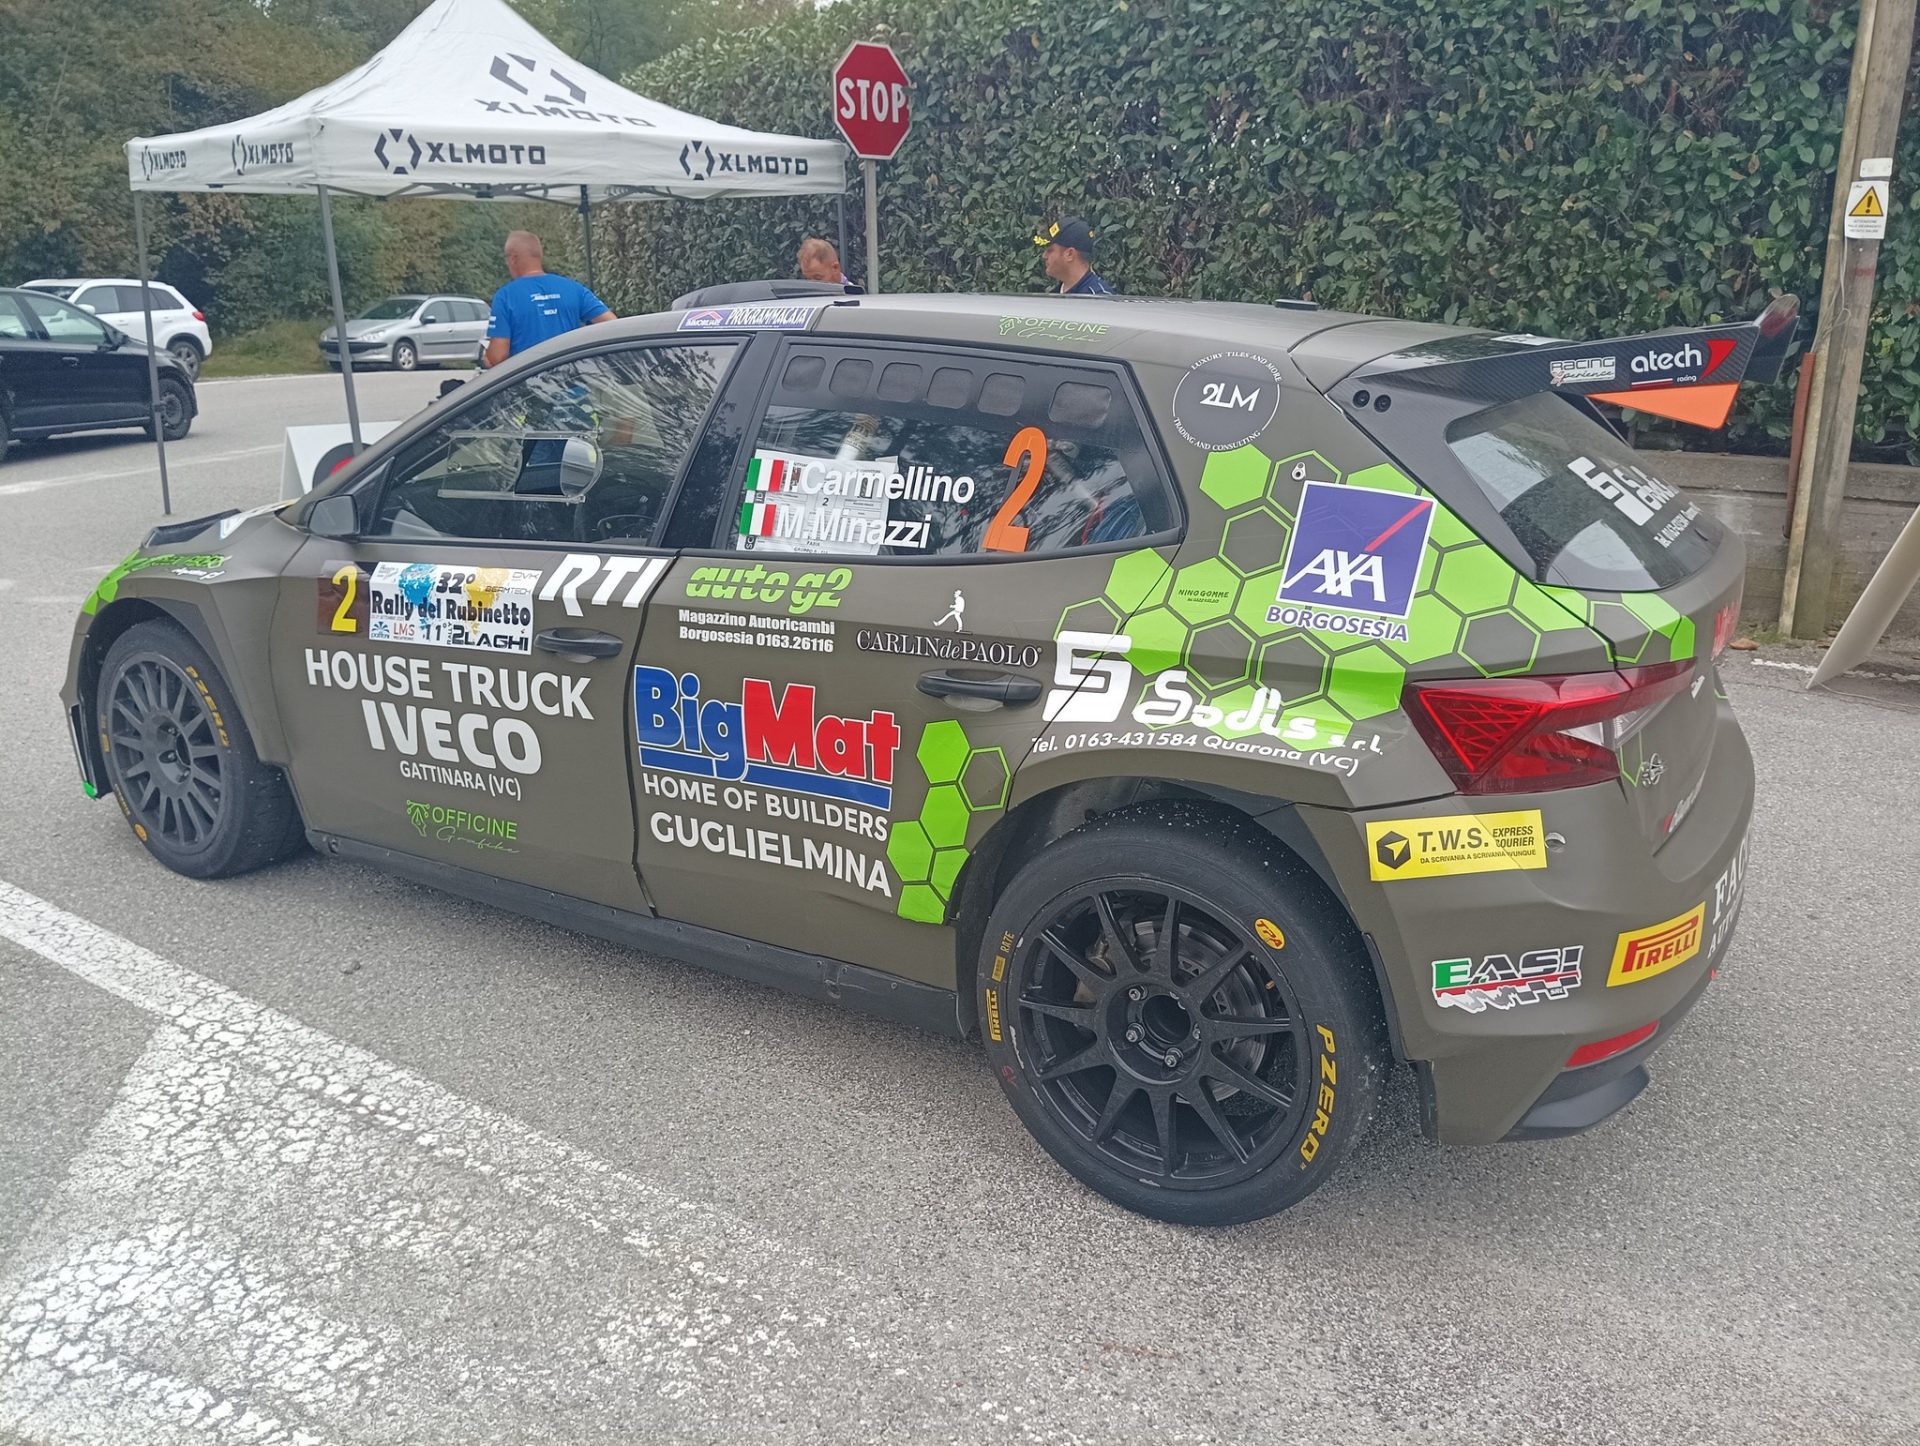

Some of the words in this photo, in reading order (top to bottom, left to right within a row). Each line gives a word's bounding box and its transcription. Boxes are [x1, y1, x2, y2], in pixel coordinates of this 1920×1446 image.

[474, 98, 657, 128] XLMOTO
[840, 77, 907, 124] STOP
[153, 150, 187, 170] XLMOTO
[248, 142, 294, 164] XLMOTO
[427, 141, 546, 166] XLMOTO
[718, 152, 809, 176] XLMOTO
[1025, 317, 1110, 335] OFFICINE
[1191, 352, 1224, 370] LUXURY
[1249, 354, 1268, 366] AND
[1265, 361, 1283, 383] MORE
[1630, 343, 1702, 374] atech
[1676, 374, 1697, 384] racing
[1200, 382, 1261, 412] 2LM
[1174, 417, 1196, 444] TRADING
[1194, 438, 1212, 451] AND
[1211, 430, 1262, 452] CONSULTING
[822, 497, 829, 507] 2
[981, 426, 1048, 553] 2
[538, 553, 669, 617] RTI
[685, 564, 790, 603] auto
[788, 567, 853, 614] g2
[1282, 548, 1387, 602] AXA
[331, 565, 358, 633] 2
[371, 590, 413, 621] Rally
[418, 596, 441, 619] del
[446, 599, 531, 626] Rubinetto
[679, 609, 747, 627] Magazzino
[749, 614, 835, 635] Autoricambi
[679, 626, 754, 647] Borgosesia
[756, 633, 834, 653] 0163.26116
[1266, 606, 1408, 642] BORGOSESIA
[305, 648, 434, 700] HOUSE
[442, 662, 595, 721] TRUCK
[361, 699, 542, 775] IVECO
[634, 665, 900, 784] BigMat
[1032, 736, 1058, 752] Tel.
[1065, 733, 1197, 749] 0163-431584
[1203, 735, 1302, 761] Quarona
[1308, 751, 1359, 777] (VC)
[400, 760, 486, 791] GATTINARA
[489, 773, 521, 801] (VC)
[432, 806, 518, 840] OFFICINE
[643, 772, 718, 806] HOME
[723, 786, 758, 811] OF
[765, 793, 888, 842] BUILDERS
[1418, 827, 1489, 853] T.W.S.
[1492, 825, 1533, 838] EXPRESS
[650, 811, 892, 897] GUGLIELMINA
[1431, 854, 1466, 863] SCRIVANIA
[1473, 851, 1506, 860] SCRIVANIA
[1622, 915, 1699, 973] PIRELLI
[1432, 945, 1583, 988] EASI
[986, 988, 1002, 1041] PIRELLI
